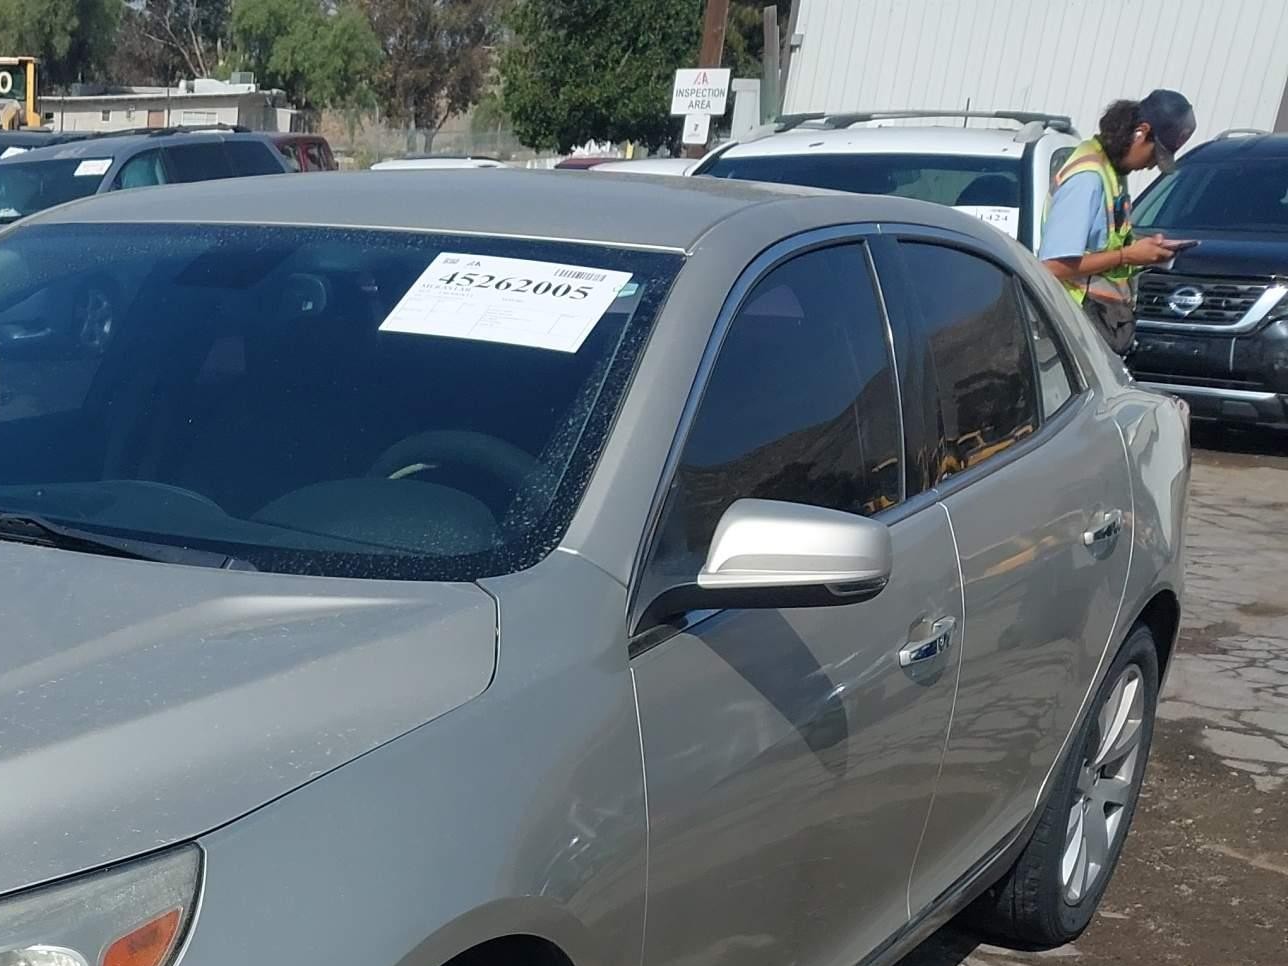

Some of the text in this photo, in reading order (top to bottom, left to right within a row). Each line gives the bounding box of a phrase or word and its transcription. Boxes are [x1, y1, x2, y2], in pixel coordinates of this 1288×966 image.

[675, 88, 726, 98] INSPECTION
[688, 100, 711, 110] AREA
[439, 272, 594, 300] 45262005
